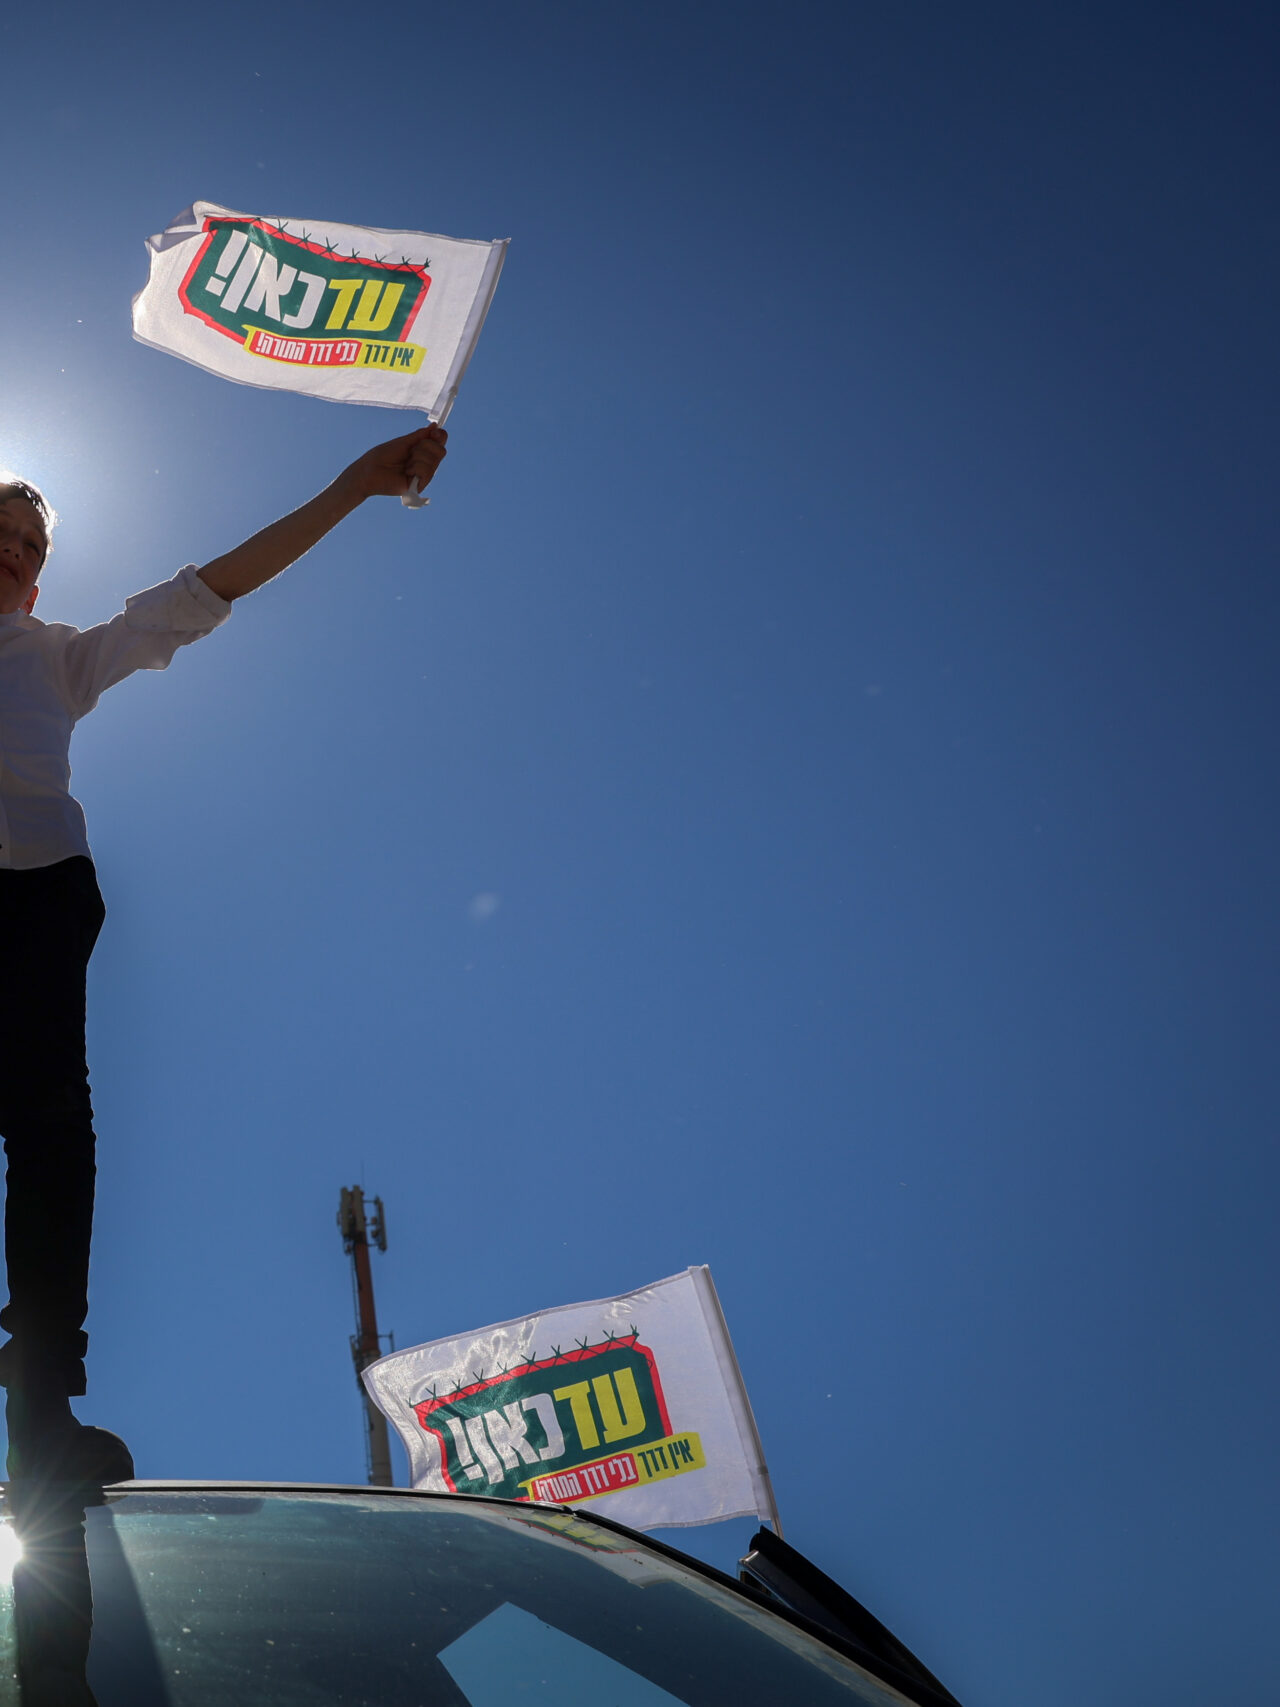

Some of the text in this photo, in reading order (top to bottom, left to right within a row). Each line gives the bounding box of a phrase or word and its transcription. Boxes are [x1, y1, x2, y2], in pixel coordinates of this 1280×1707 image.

[205, 229, 405, 331] עד כאן!
[309, 343, 334, 364] דרך
[336, 341, 358, 362] בלי
[364, 344, 390, 364] דרך
[389, 346, 414, 367] אין
[446, 1367, 646, 1484] עד כאן!
[638, 1446, 668, 1478] דרך
[667, 1438, 694, 1470] אין
[580, 1464, 610, 1495] דרך
[609, 1456, 636, 1483] בלי
